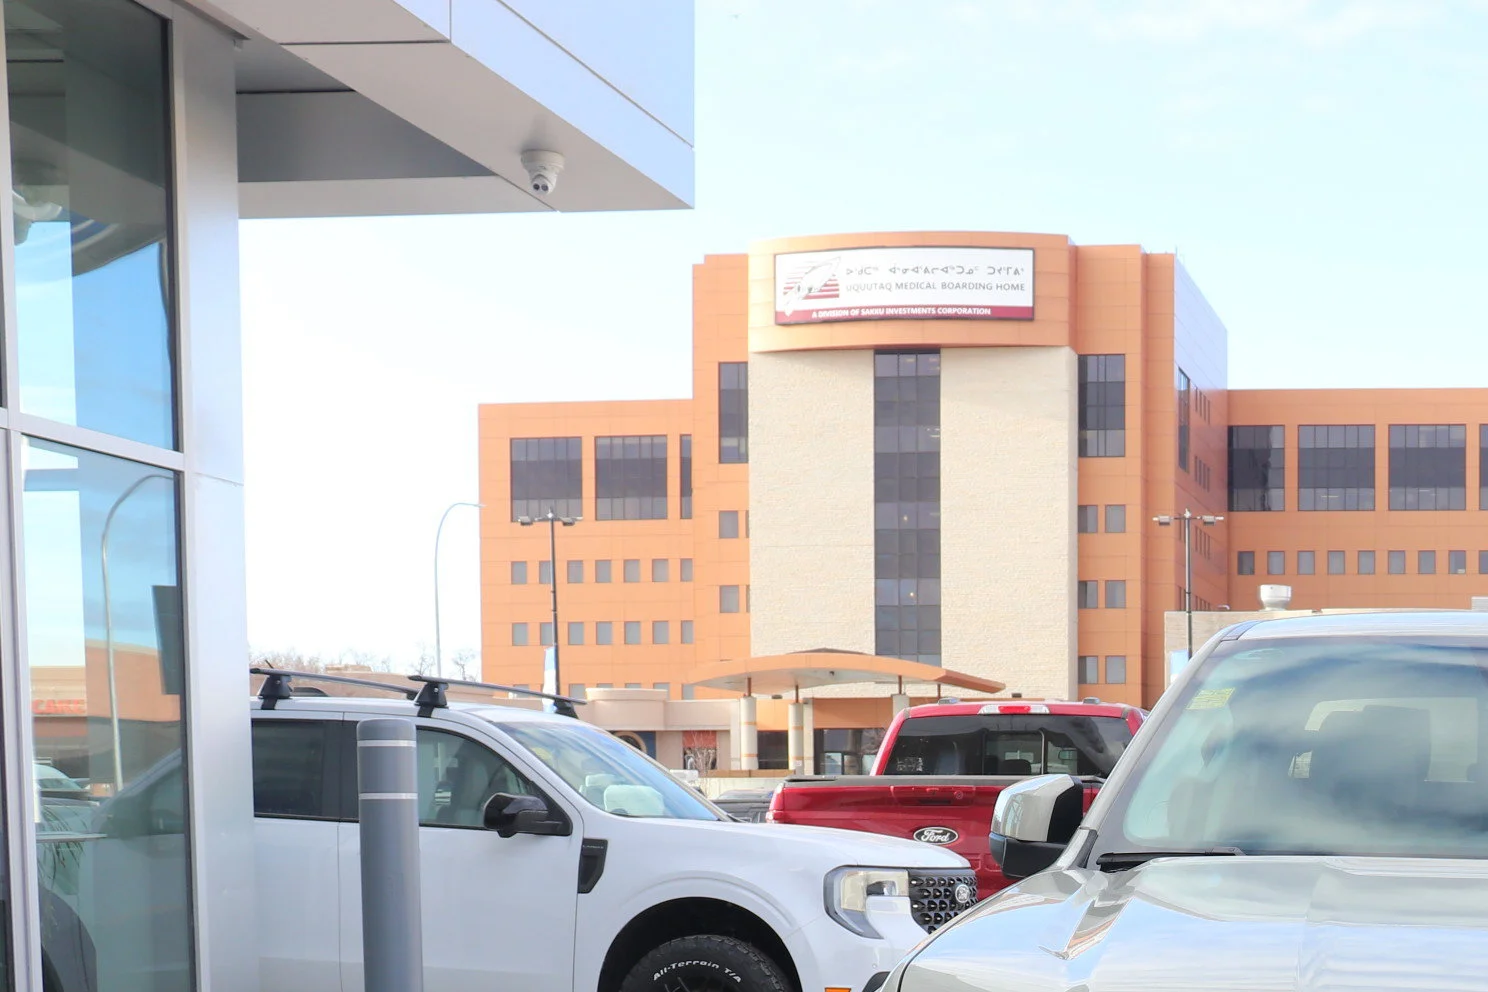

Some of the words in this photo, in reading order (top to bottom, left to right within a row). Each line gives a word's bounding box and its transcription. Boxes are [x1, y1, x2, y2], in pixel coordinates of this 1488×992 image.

[895, 281, 936, 290] MEDICAL
[941, 281, 993, 291] BOARDING
[996, 282, 1025, 291] HOME
[818, 309, 849, 317] DIVISION
[850, 308, 860, 316] OF
[885, 307, 936, 315] INVESTMENTS
[937, 307, 992, 315] CORPORATION
[921, 829, 950, 842] Ford
[653, 960, 720, 981] All-Terrain
[724, 967, 742, 983] T/A
